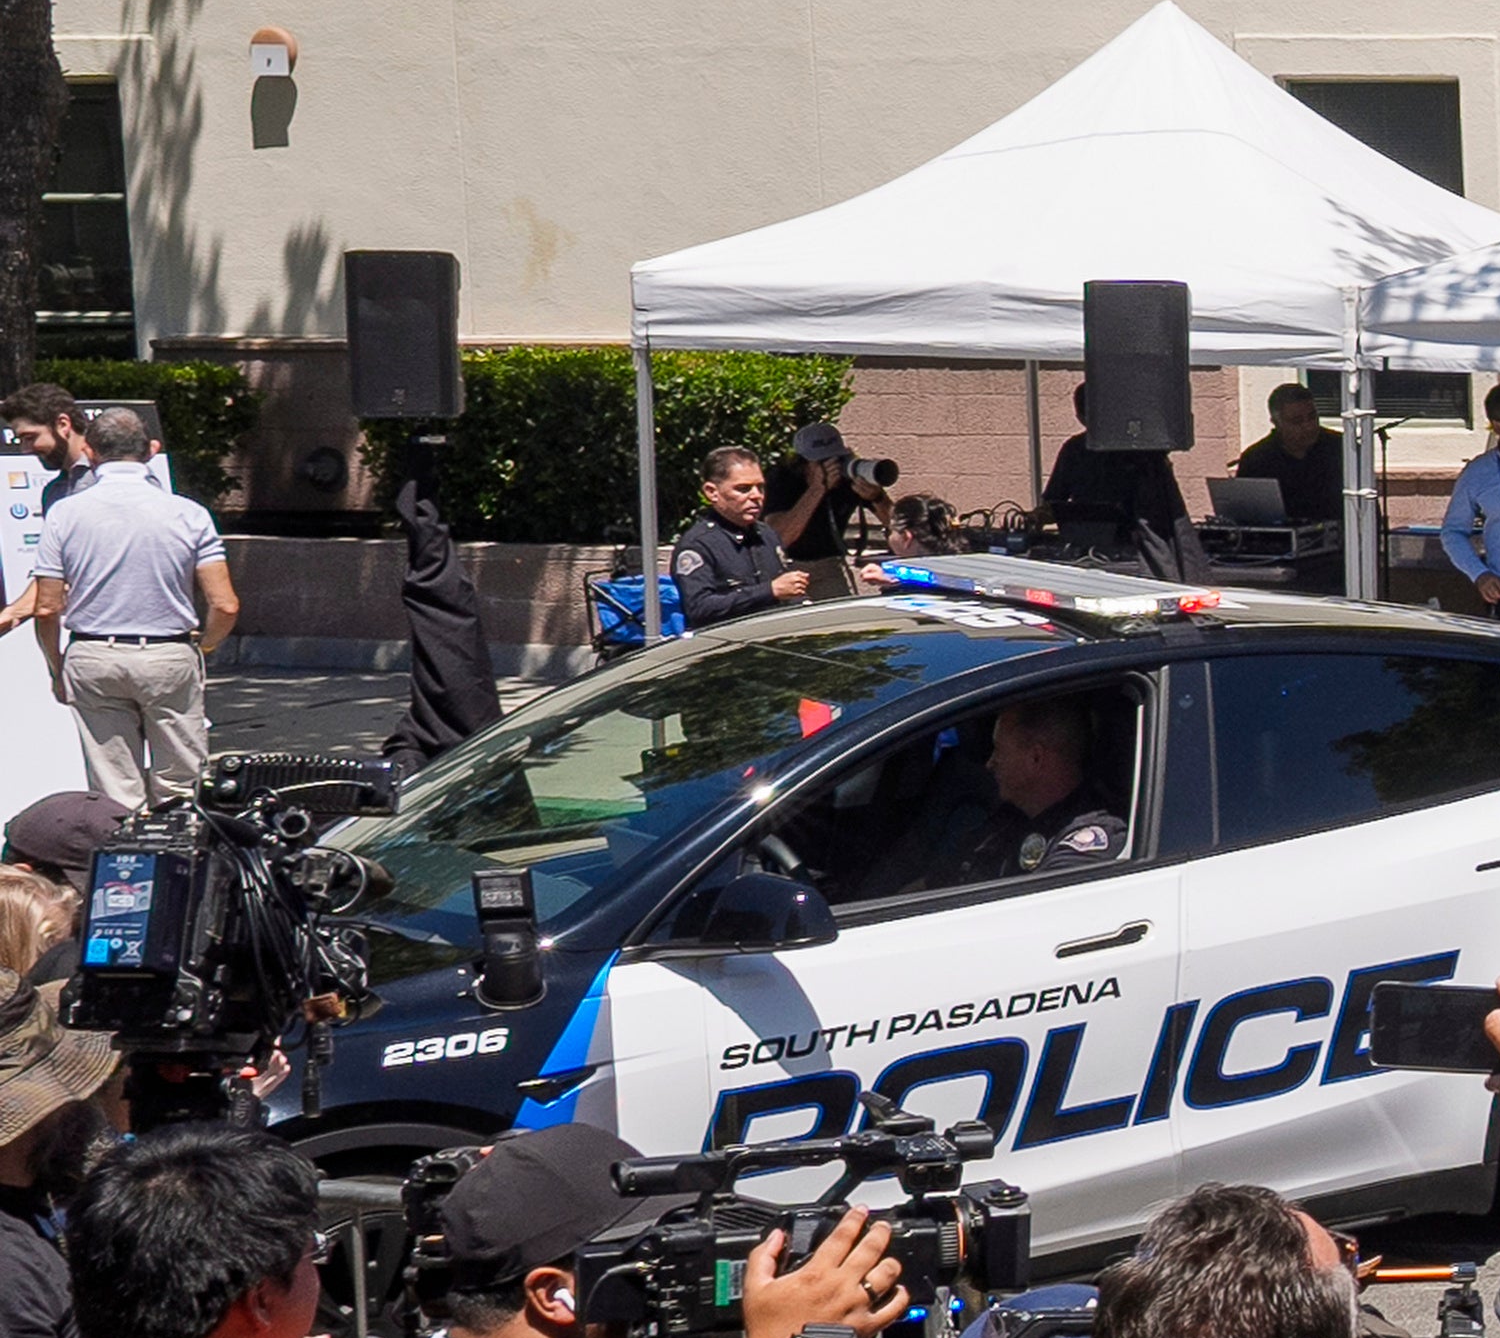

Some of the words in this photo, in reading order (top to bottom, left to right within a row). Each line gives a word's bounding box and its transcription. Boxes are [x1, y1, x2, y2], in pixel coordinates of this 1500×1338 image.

[381, 1027, 510, 1070] 2306
[720, 1019, 881, 1071] SOUTH
[887, 976, 1122, 1038] PASADENA
